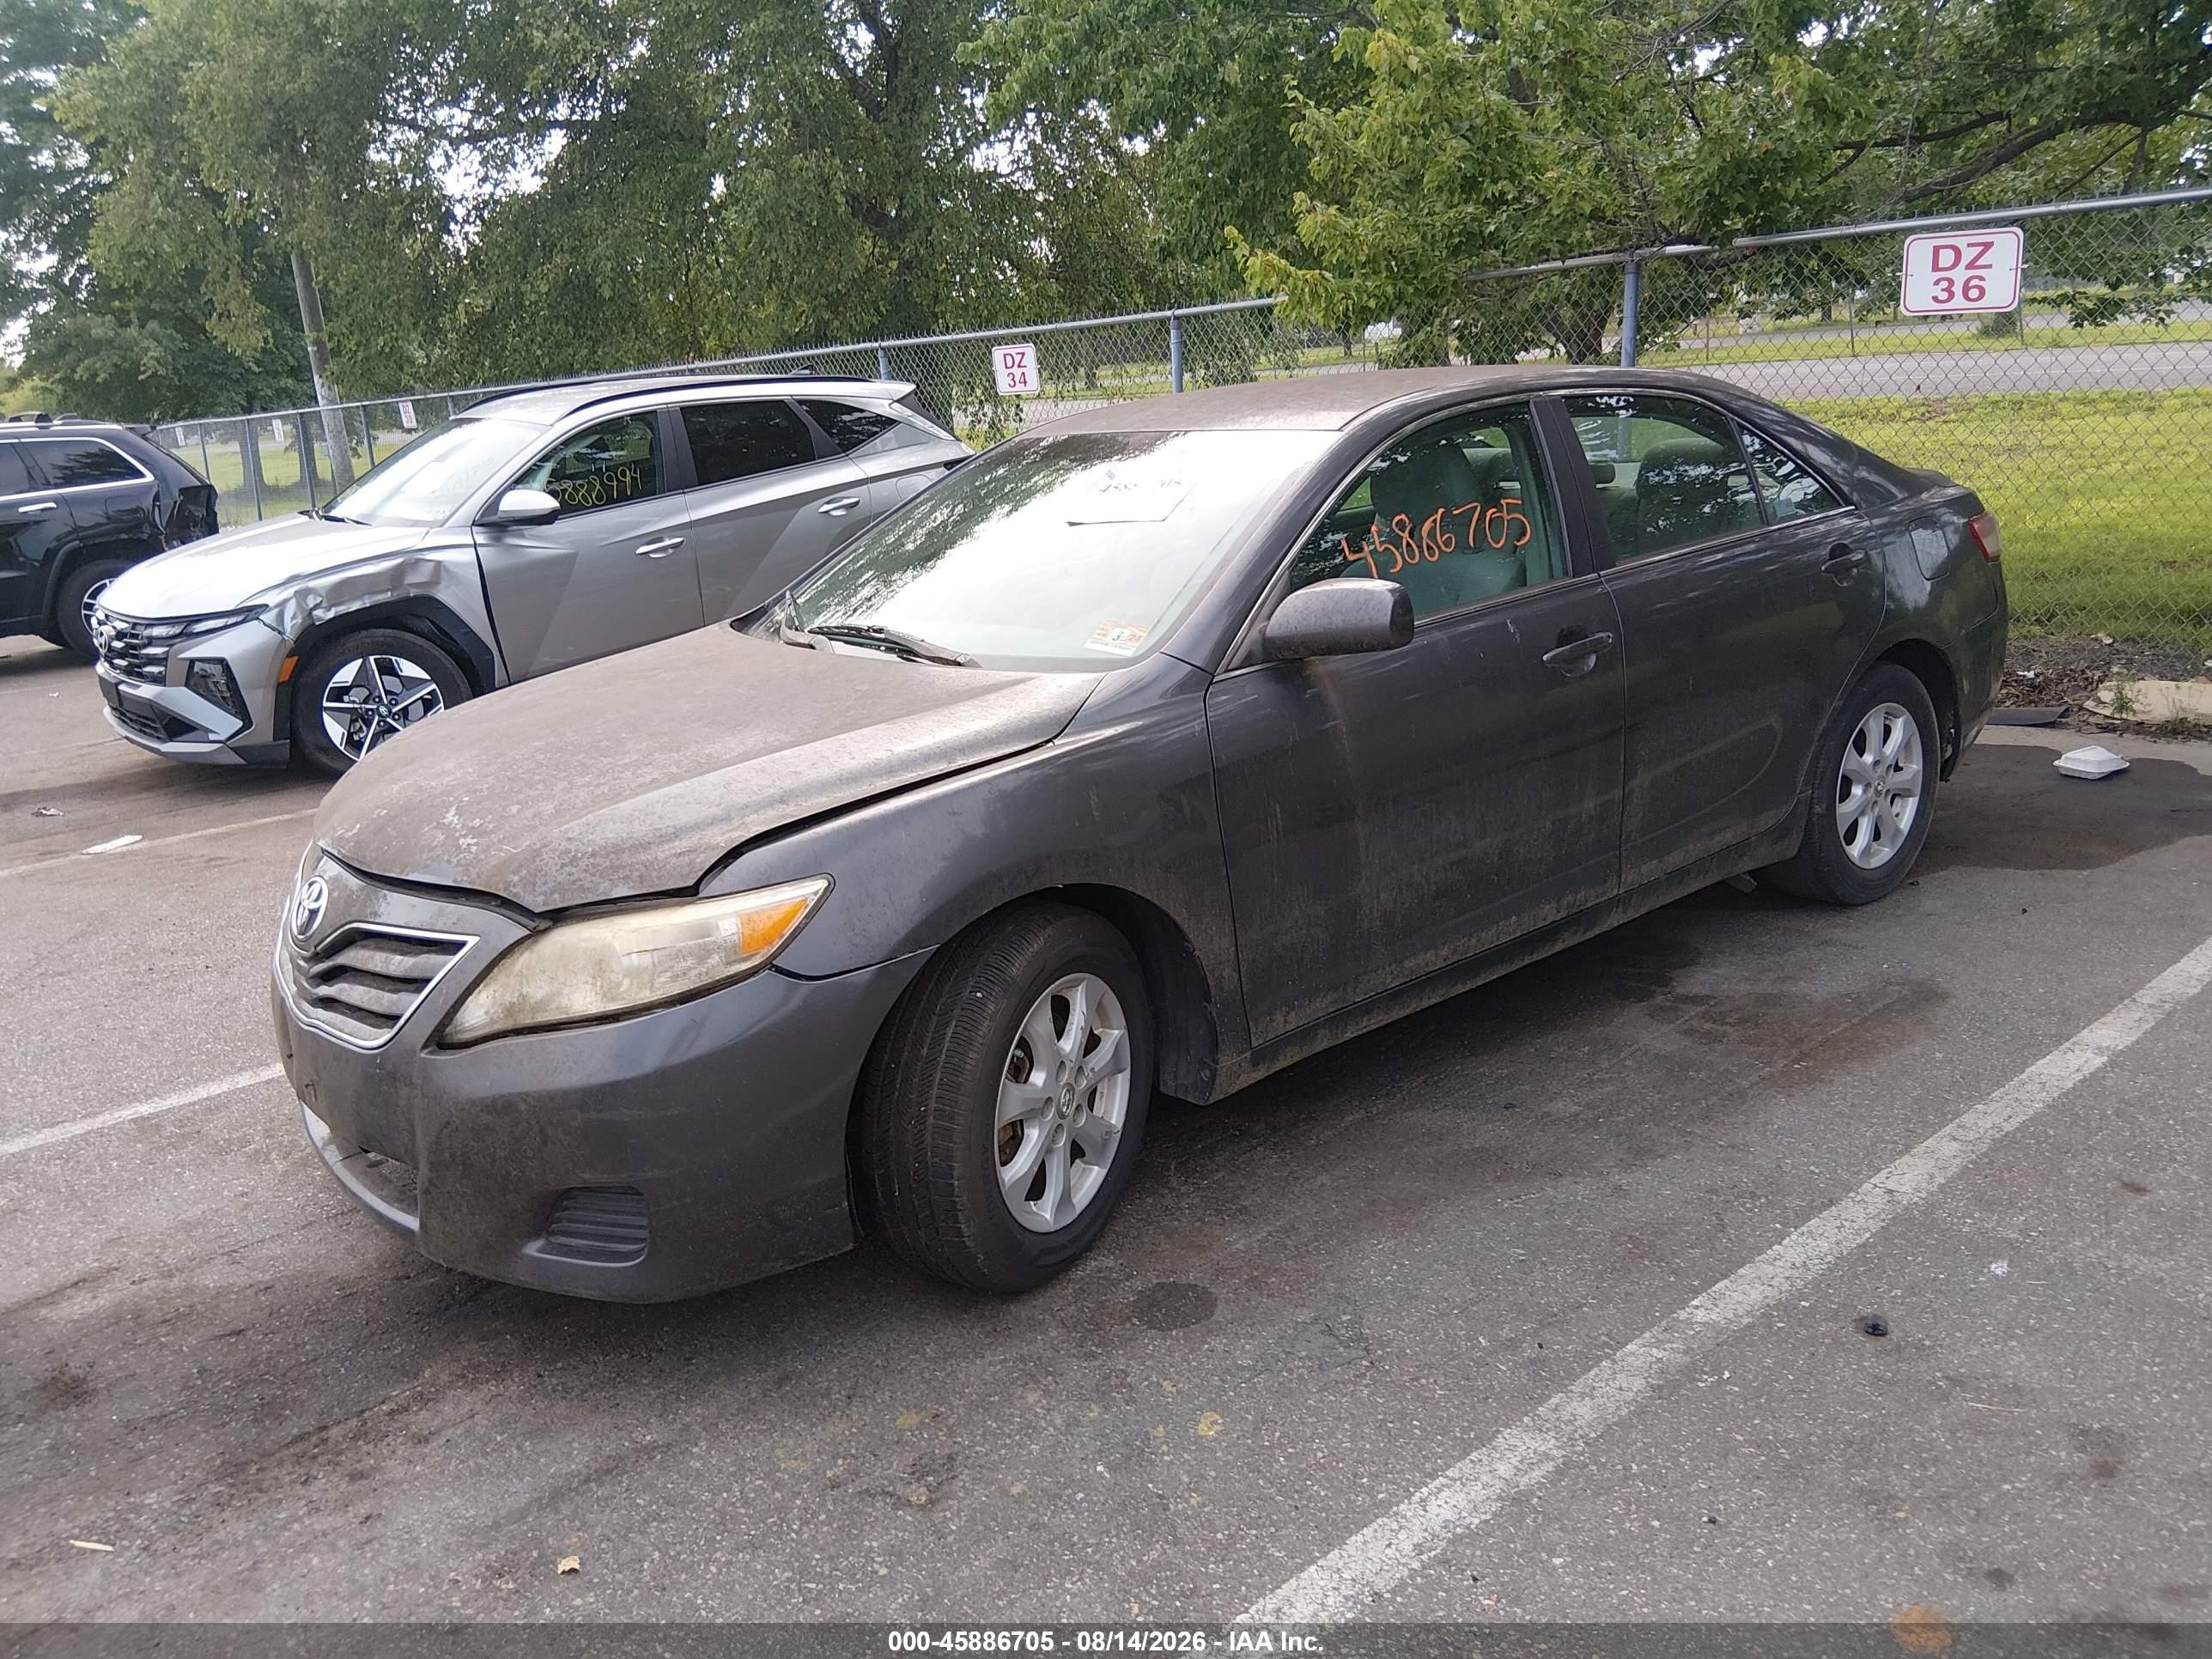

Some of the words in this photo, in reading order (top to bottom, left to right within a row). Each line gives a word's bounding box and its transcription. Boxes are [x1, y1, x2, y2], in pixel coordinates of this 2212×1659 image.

[1931, 241, 1995, 272] DZ
[1931, 275, 1986, 304] 36
[1003, 352, 1027, 369] DZ
[1007, 372, 1028, 388] 34
